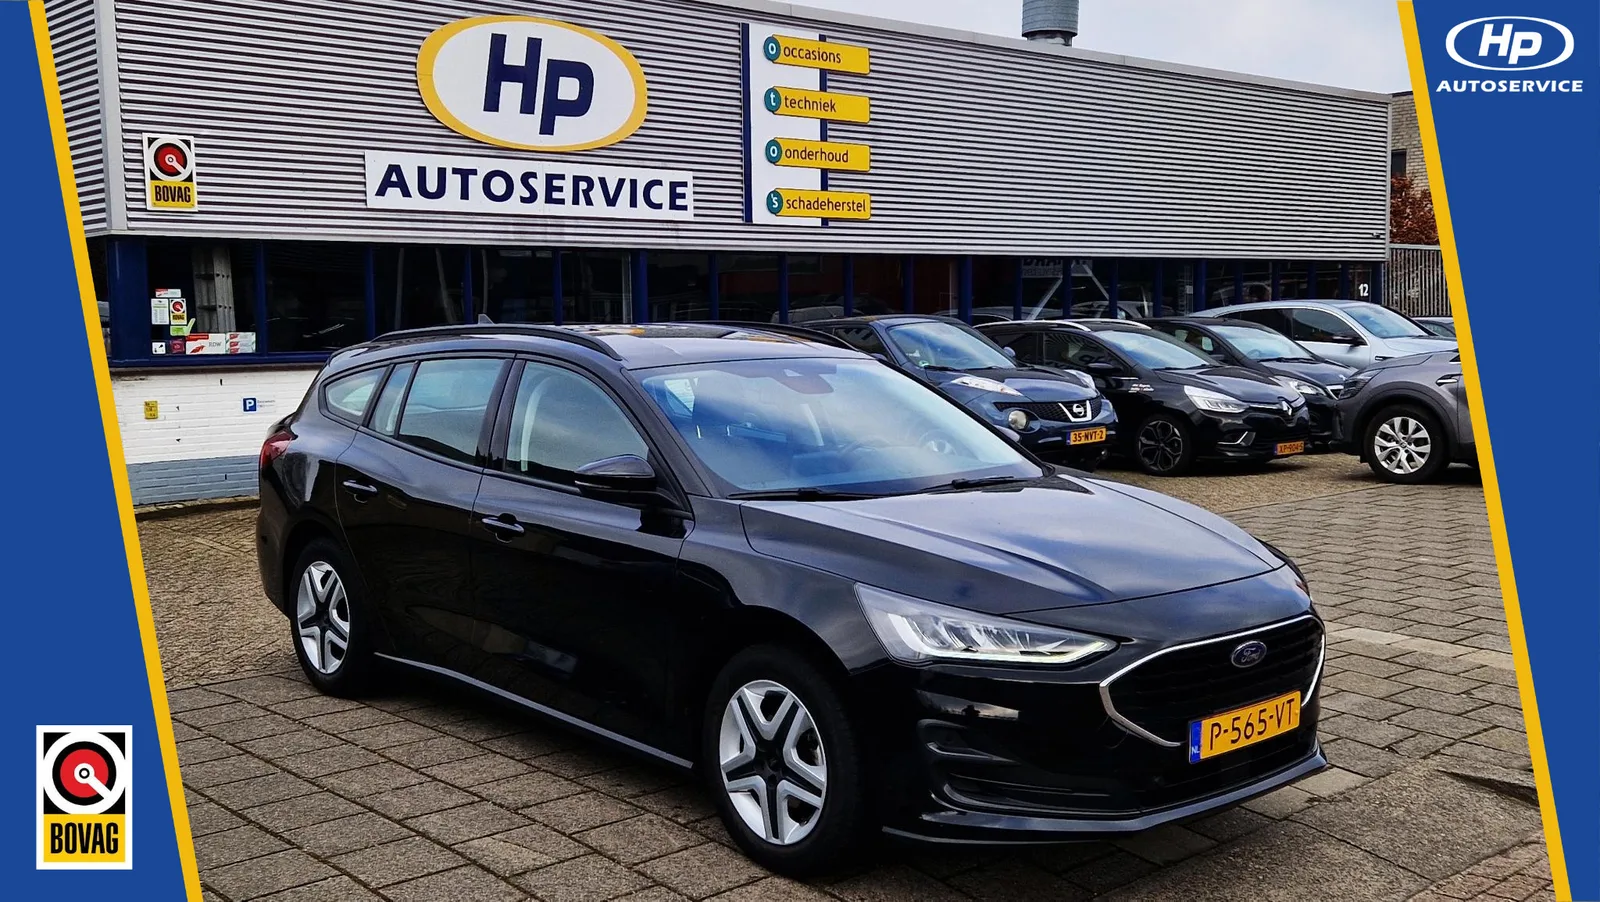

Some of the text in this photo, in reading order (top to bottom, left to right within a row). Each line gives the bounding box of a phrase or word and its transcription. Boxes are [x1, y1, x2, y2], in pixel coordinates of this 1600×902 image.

[783, 46, 841, 64] occasions
[784, 95, 837, 113] techniek
[784, 147, 849, 163] onderhoud
[154, 185, 191, 203] BOVAG
[375, 163, 689, 211] AUTOSERVICE
[786, 196, 866, 213] schadeherstel
[1358, 283, 1369, 297] 12
[246, 399, 255, 411] P
[1072, 430, 1104, 443] 35-NVT-2
[1240, 647, 1261, 663] Ford
[1191, 698, 1295, 755] NL P-565-VT
